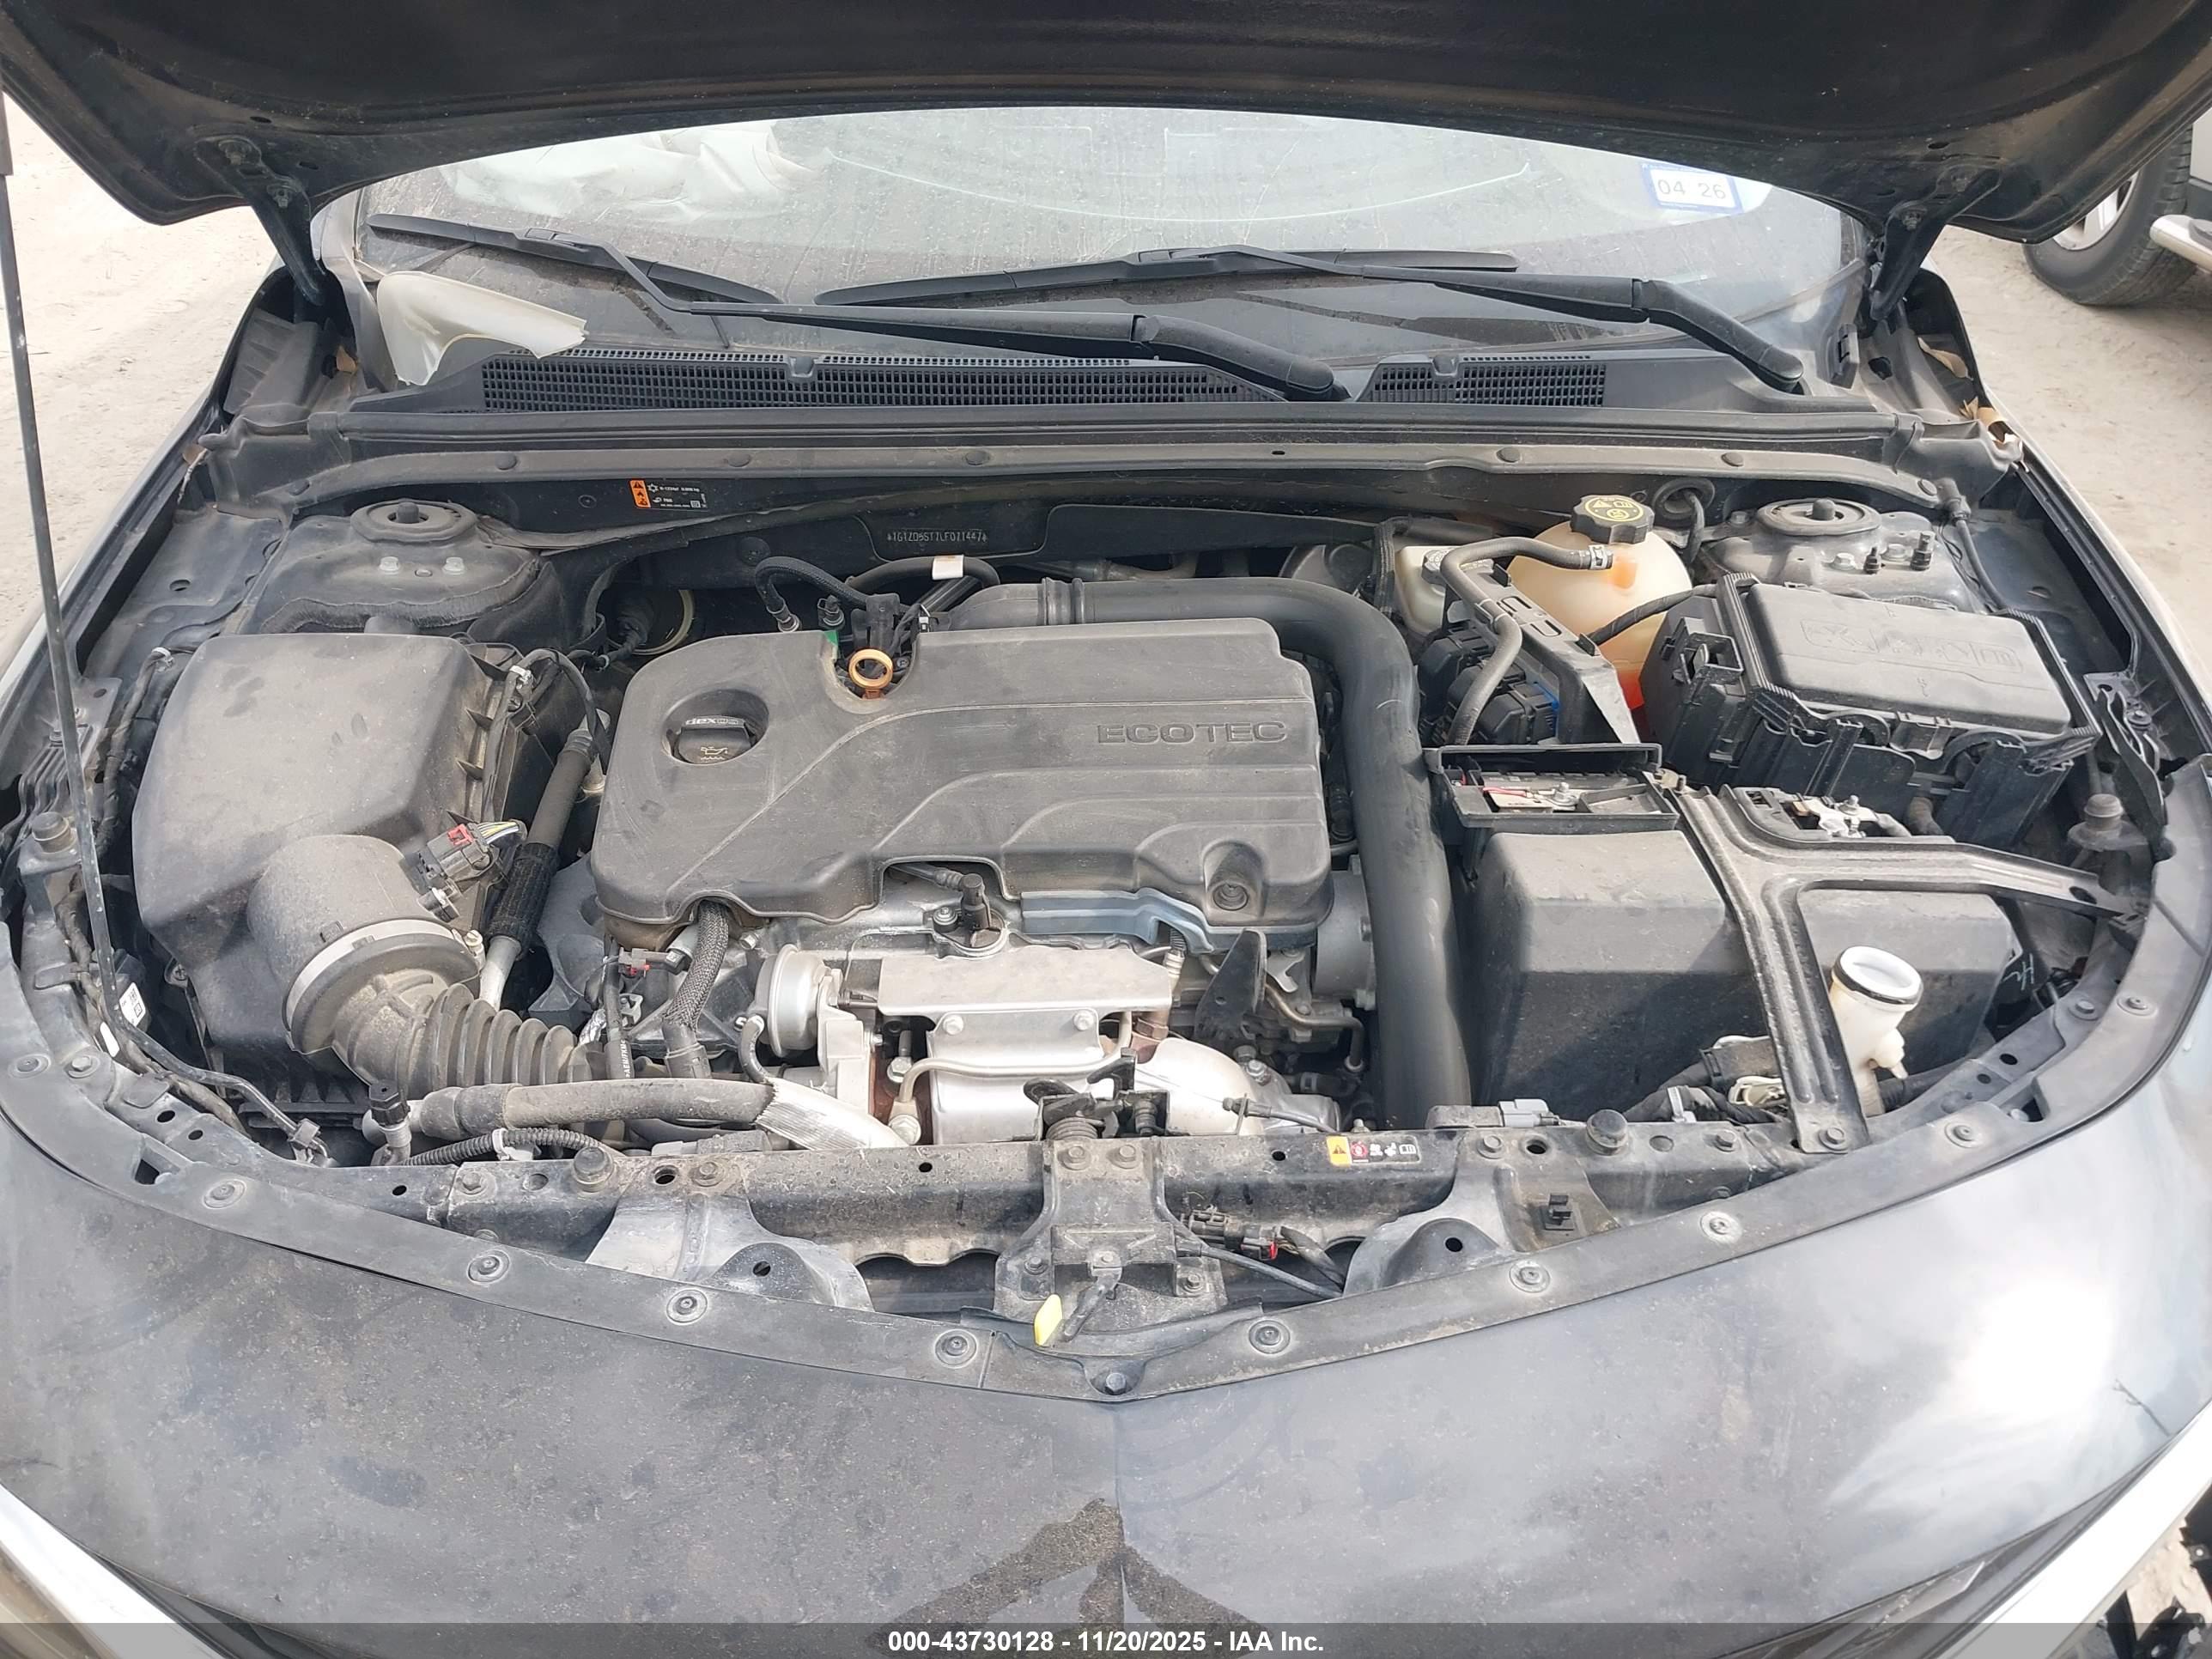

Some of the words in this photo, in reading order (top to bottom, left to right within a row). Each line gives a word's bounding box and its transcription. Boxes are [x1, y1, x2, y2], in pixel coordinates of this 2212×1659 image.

[1657, 179, 1686, 196] 04
[1697, 182, 1727, 200] 26
[1097, 721, 1288, 744] ECOTEC
